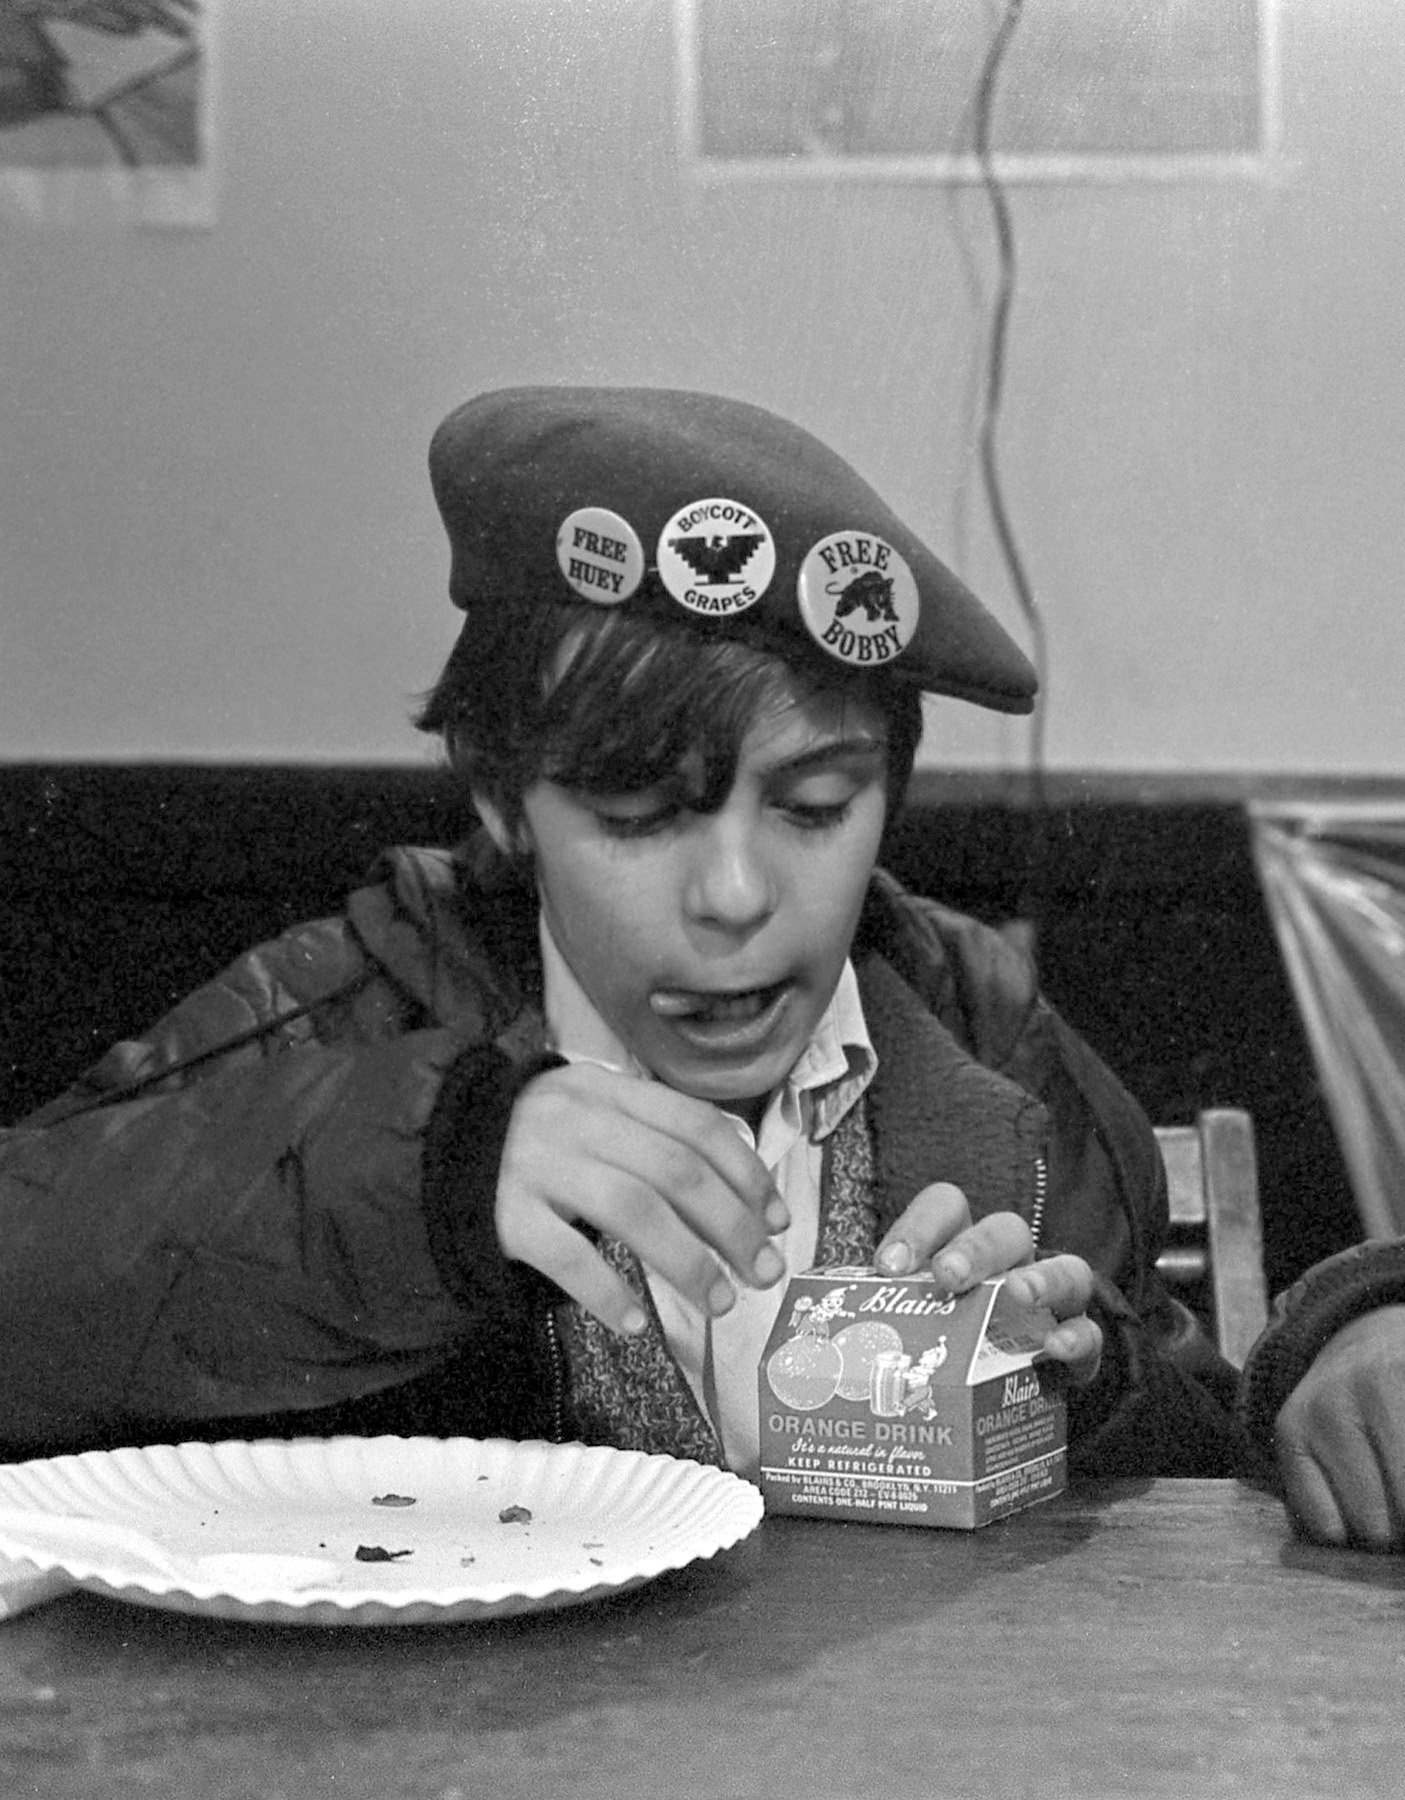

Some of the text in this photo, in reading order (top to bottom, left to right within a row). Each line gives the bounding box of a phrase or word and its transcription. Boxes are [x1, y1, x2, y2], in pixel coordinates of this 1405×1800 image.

[676, 505, 757, 533] BOYCOTT
[572, 527, 627, 564] FREE
[818, 538, 892, 574] FREE
[568, 557, 625, 595] HUEY
[683, 585, 757, 612] GRAPES
[820, 618, 905, 662] BOBBY
[768, 1413, 866, 1440] ORANGE
[875, 1422, 955, 1446] DRINK
[976, 1404, 1027, 1436] ORANGE
[792, 1436, 927, 1463] It's a natural in flavor
[787, 1456, 932, 1477] KEEP REFRIGERATED
[791, 1494, 835, 1506] CONTENTS
[878, 1500, 898, 1511] PINT
[899, 1501, 929, 1513] LIQUID
[803, 1485, 828, 1495] AREA
[828, 1486, 852, 1498] CODE
